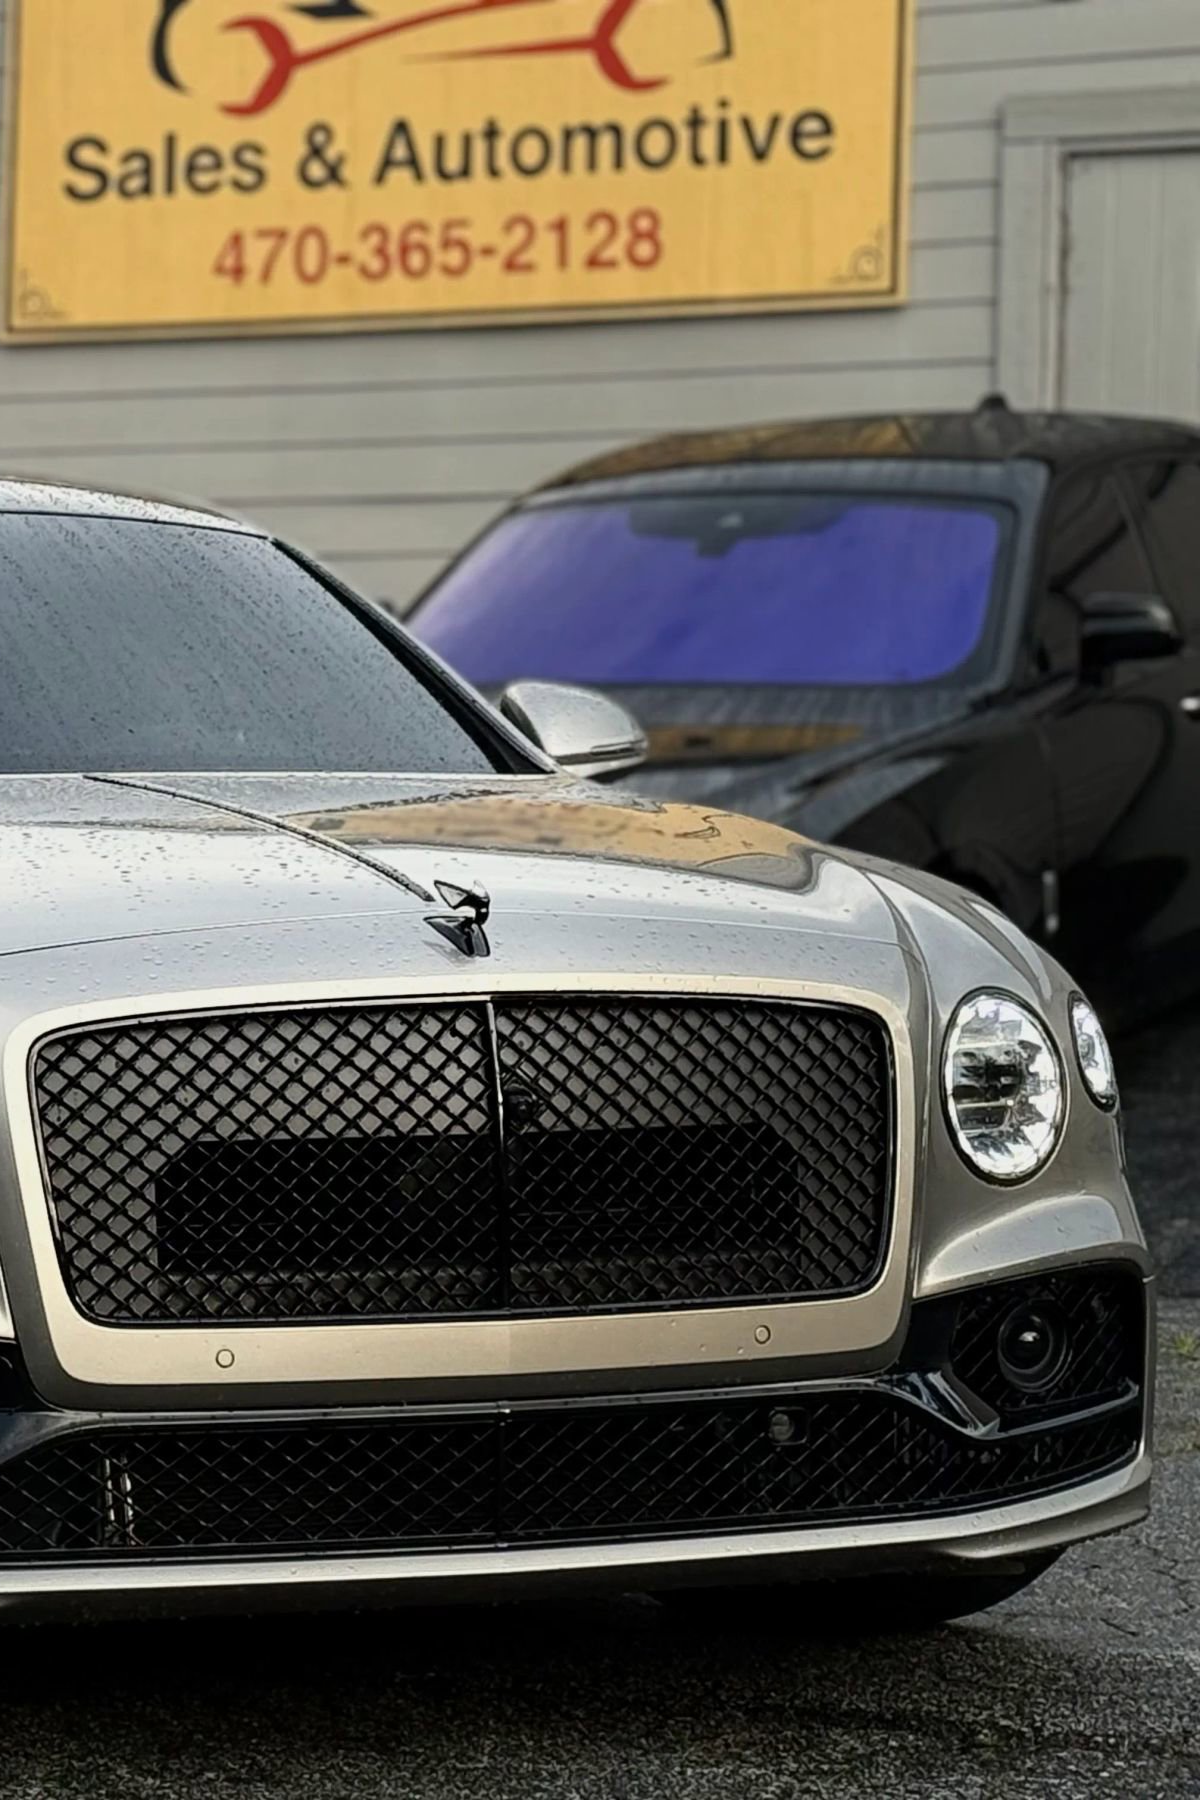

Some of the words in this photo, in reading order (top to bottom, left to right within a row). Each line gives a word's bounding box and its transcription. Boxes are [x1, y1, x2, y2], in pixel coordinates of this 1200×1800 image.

[63, 132, 266, 201] Sales
[297, 122, 346, 188] &
[373, 98, 835, 185] Automotive
[212, 208, 662, 285] 470-365-2128
